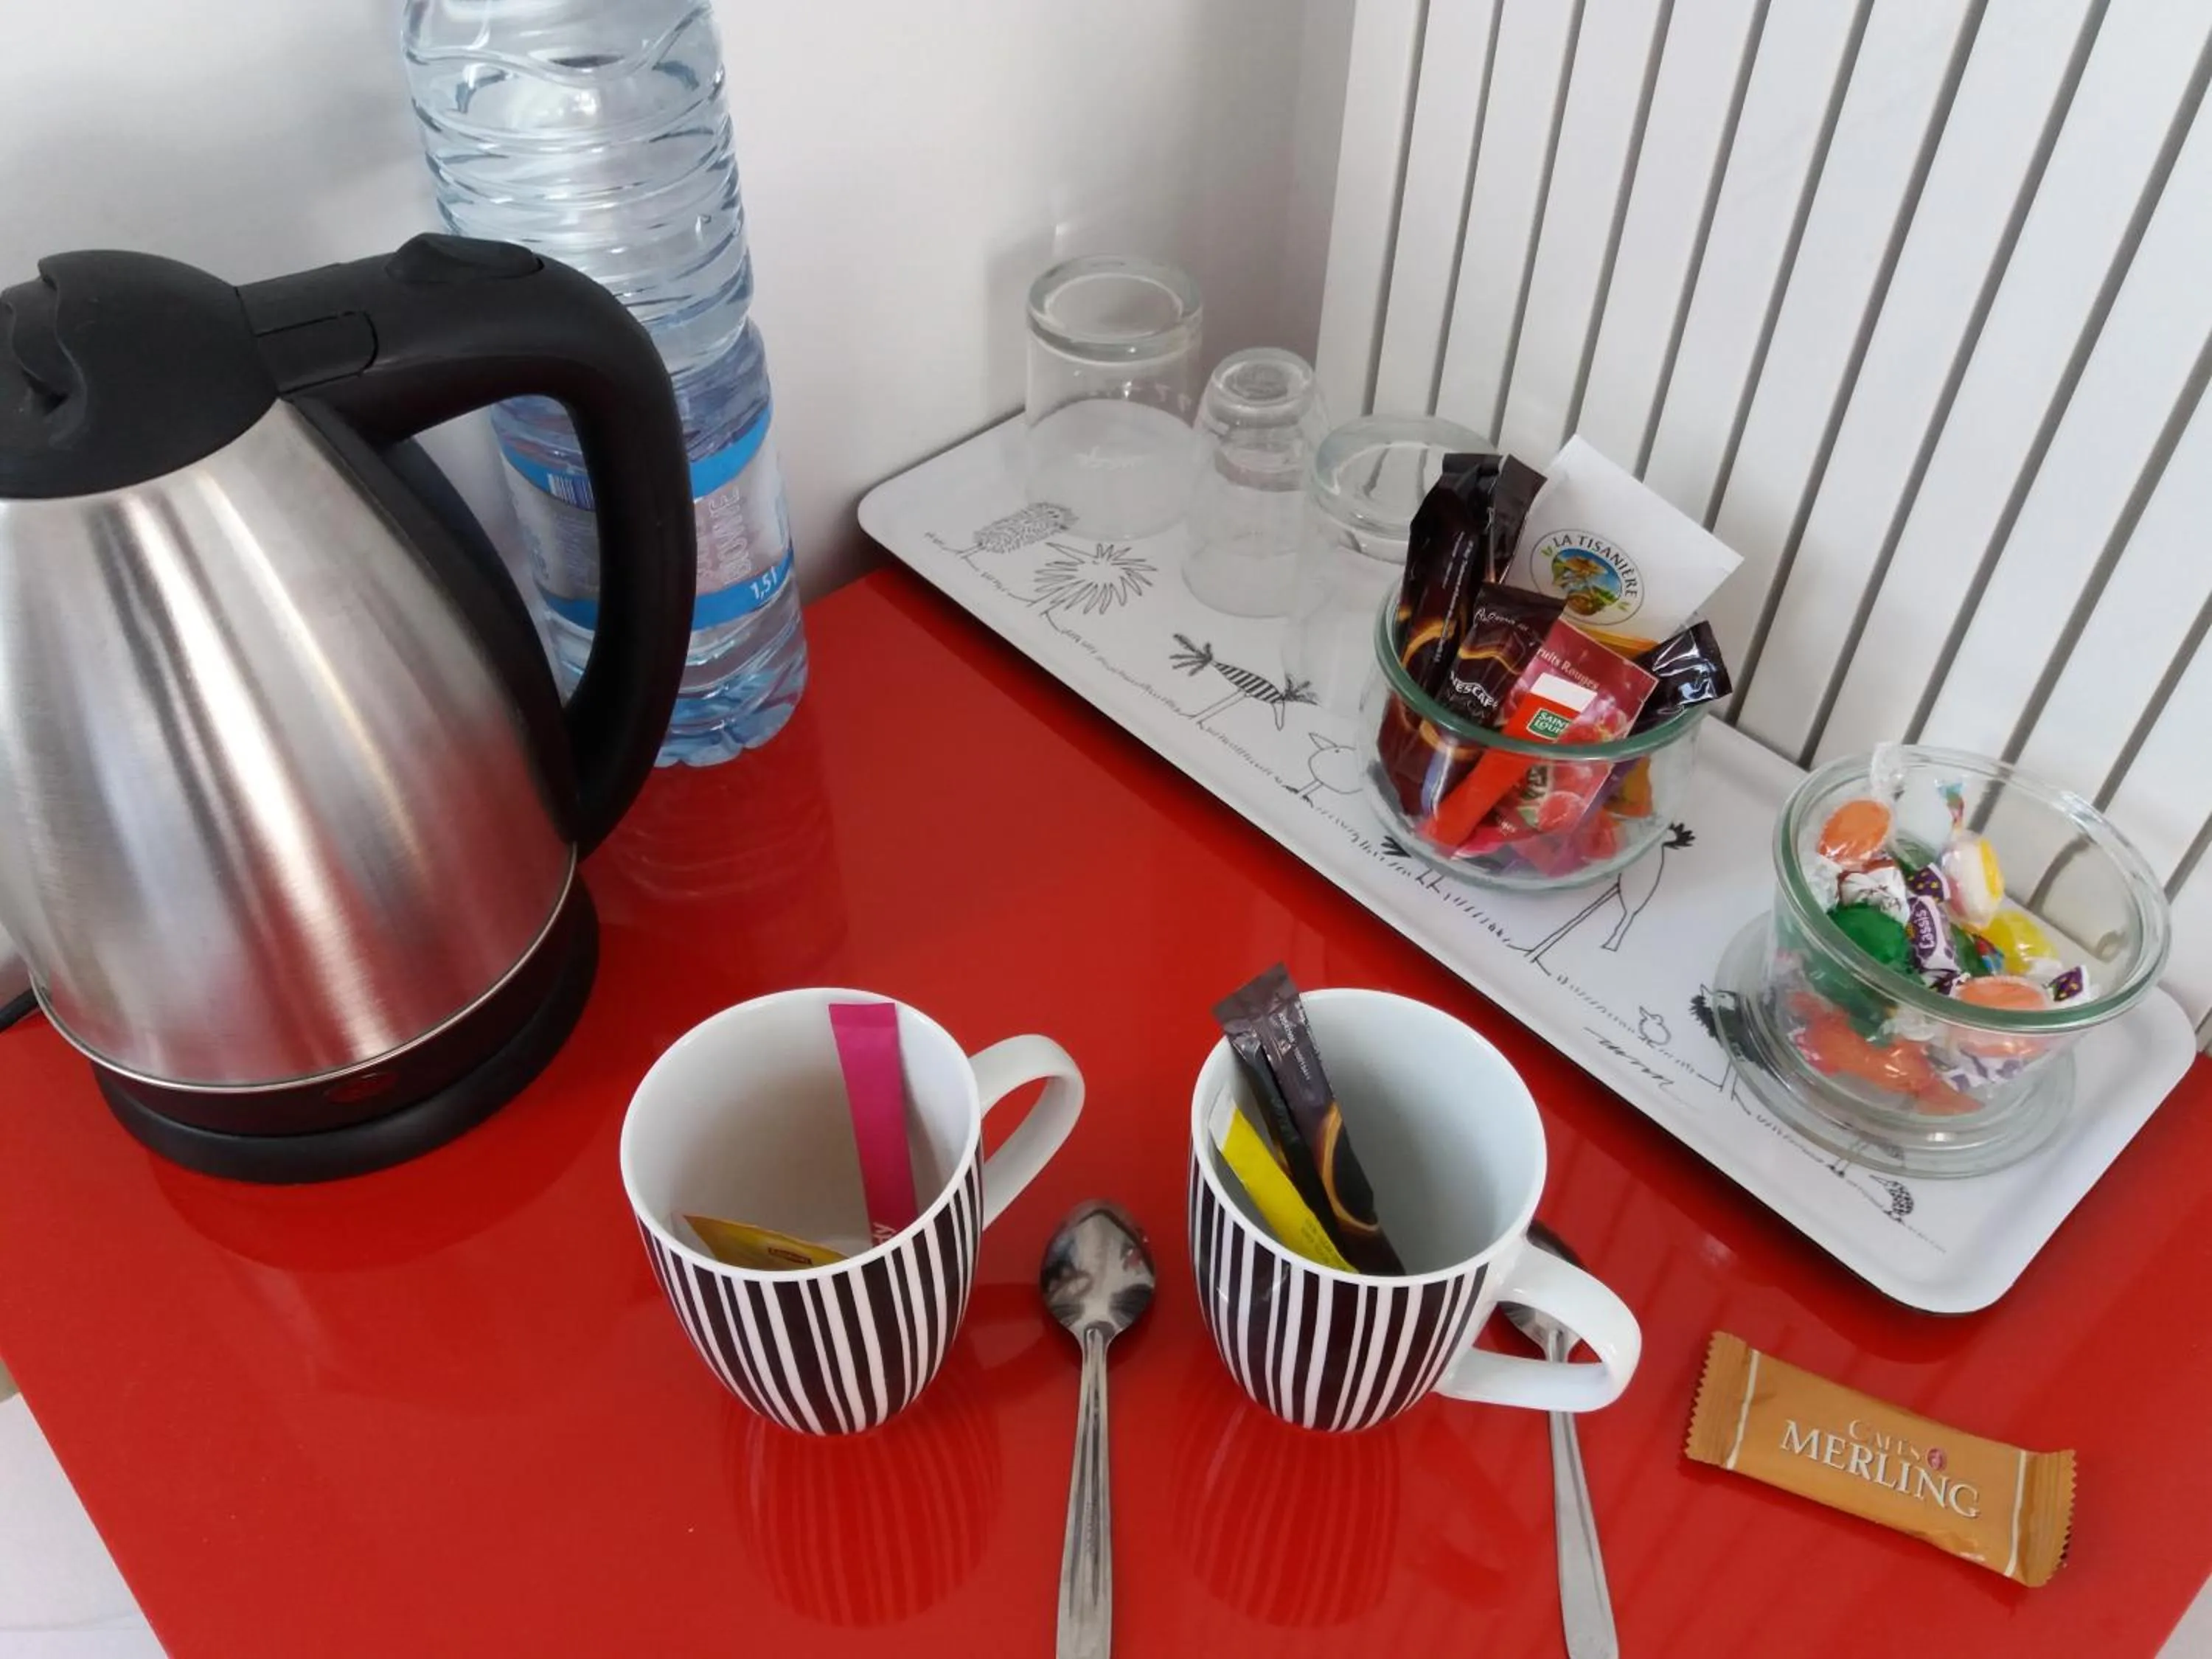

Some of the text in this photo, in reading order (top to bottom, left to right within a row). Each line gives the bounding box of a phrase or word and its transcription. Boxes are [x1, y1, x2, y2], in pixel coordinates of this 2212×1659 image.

[1553, 534, 1638, 597] LA TISANIÈRE
[1536, 647, 1599, 690] ruits Rouges
[1914, 908, 1935, 949] Cassis
[1780, 1419, 1980, 1518] MERLING
